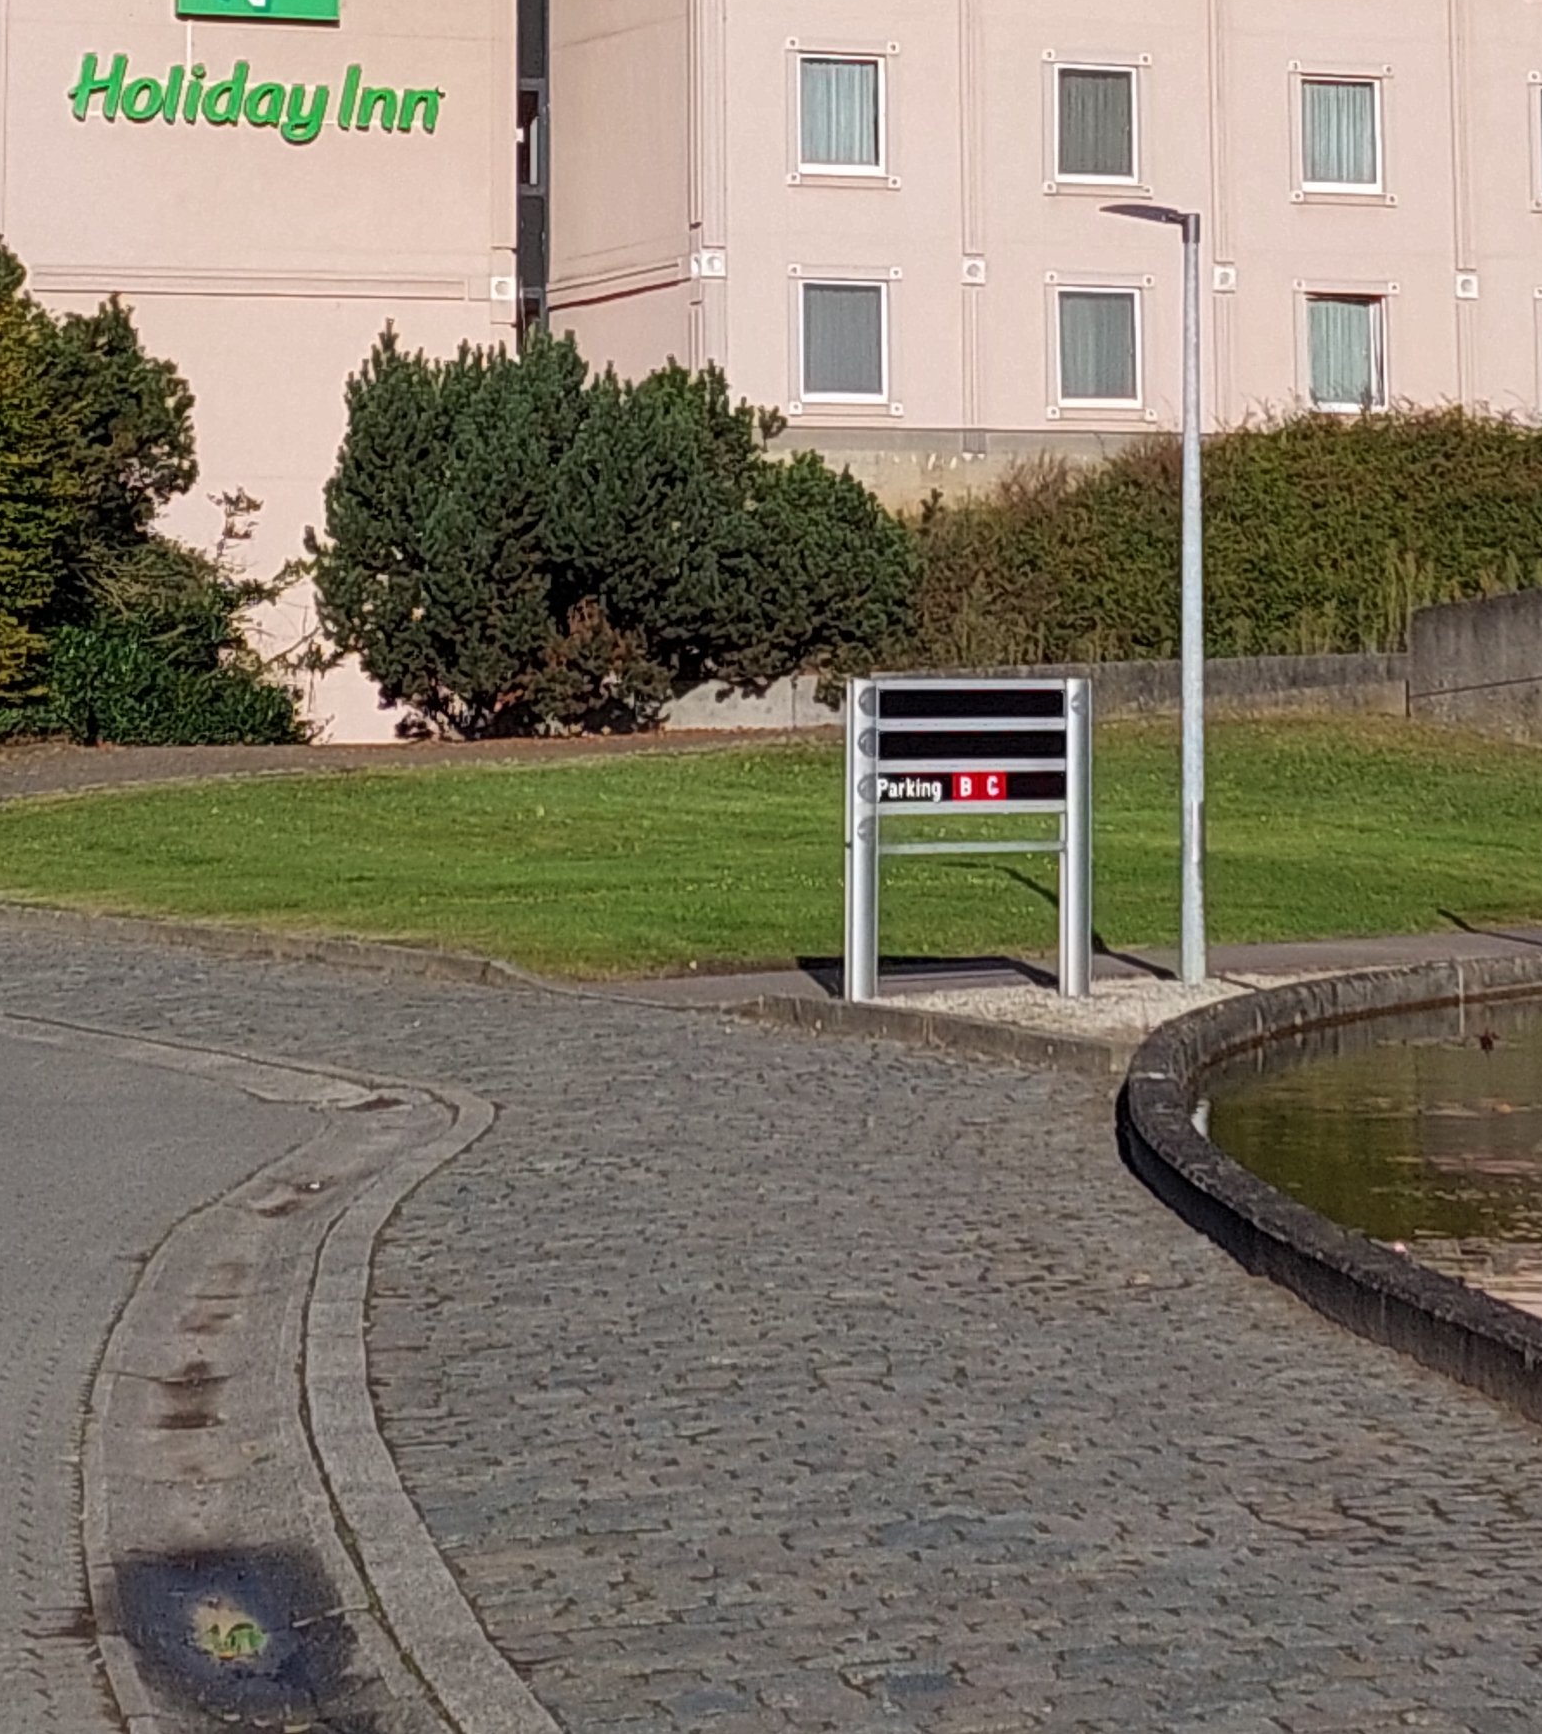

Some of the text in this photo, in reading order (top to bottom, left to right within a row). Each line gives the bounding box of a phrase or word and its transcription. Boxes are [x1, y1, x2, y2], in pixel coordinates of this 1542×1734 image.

[68, 52, 445, 144] Holiday Inn
[876, 775, 999, 803] Parking B C
